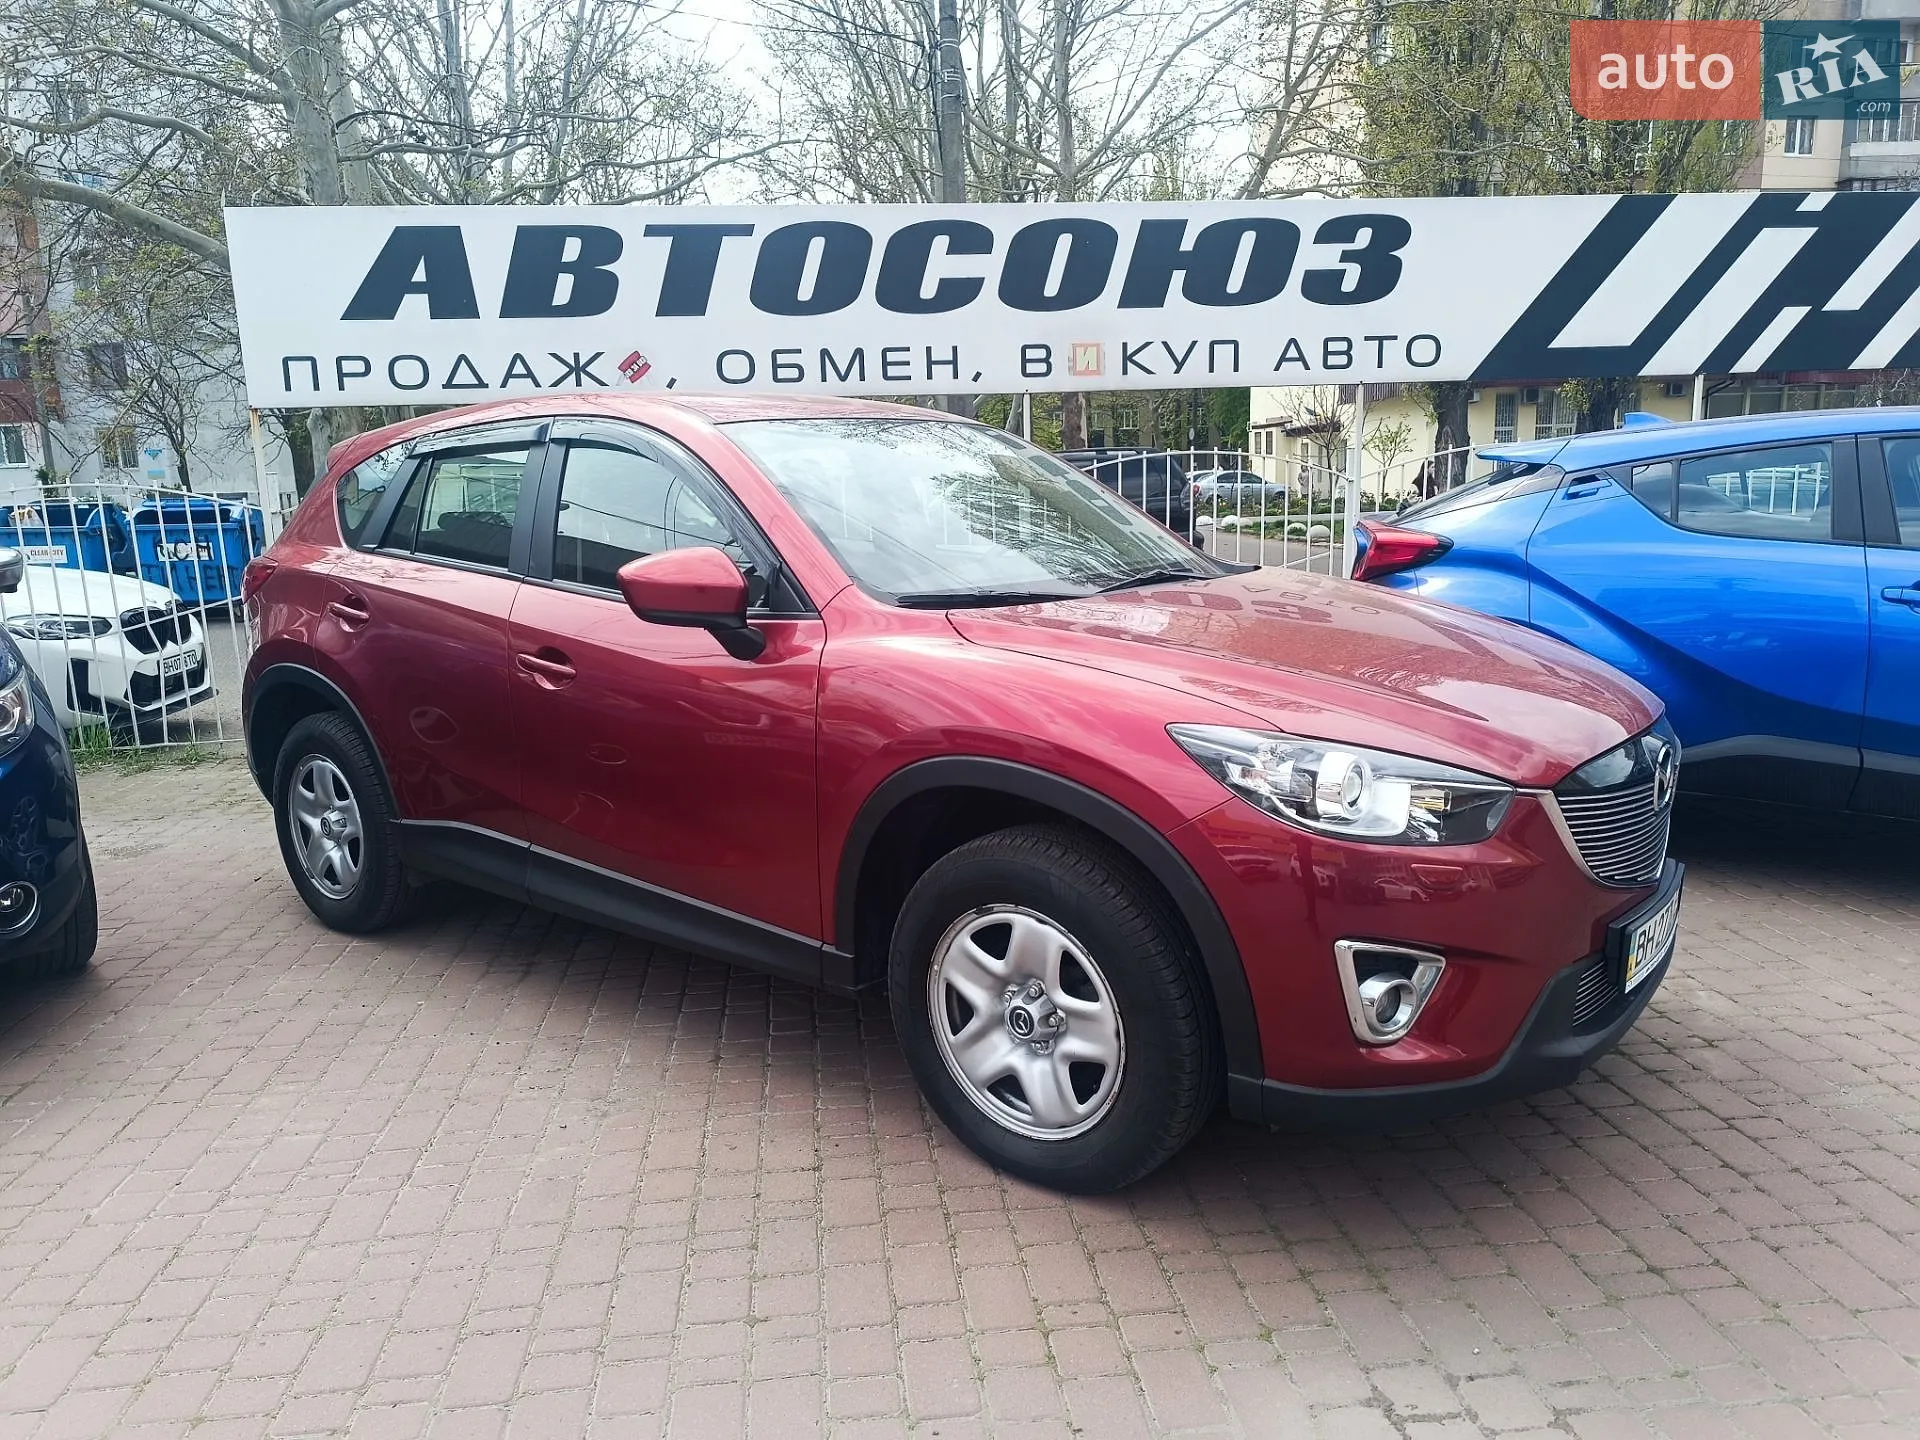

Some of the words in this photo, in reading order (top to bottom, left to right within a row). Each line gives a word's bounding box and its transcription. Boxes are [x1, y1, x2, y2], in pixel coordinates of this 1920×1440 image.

[339, 213, 1413, 321] АВТОСОЮЗ
[281, 349, 678, 392] ПРОДАЖ,
[715, 344, 983, 385] ОБМЕН,
[1272, 333, 1443, 373] АВТО
